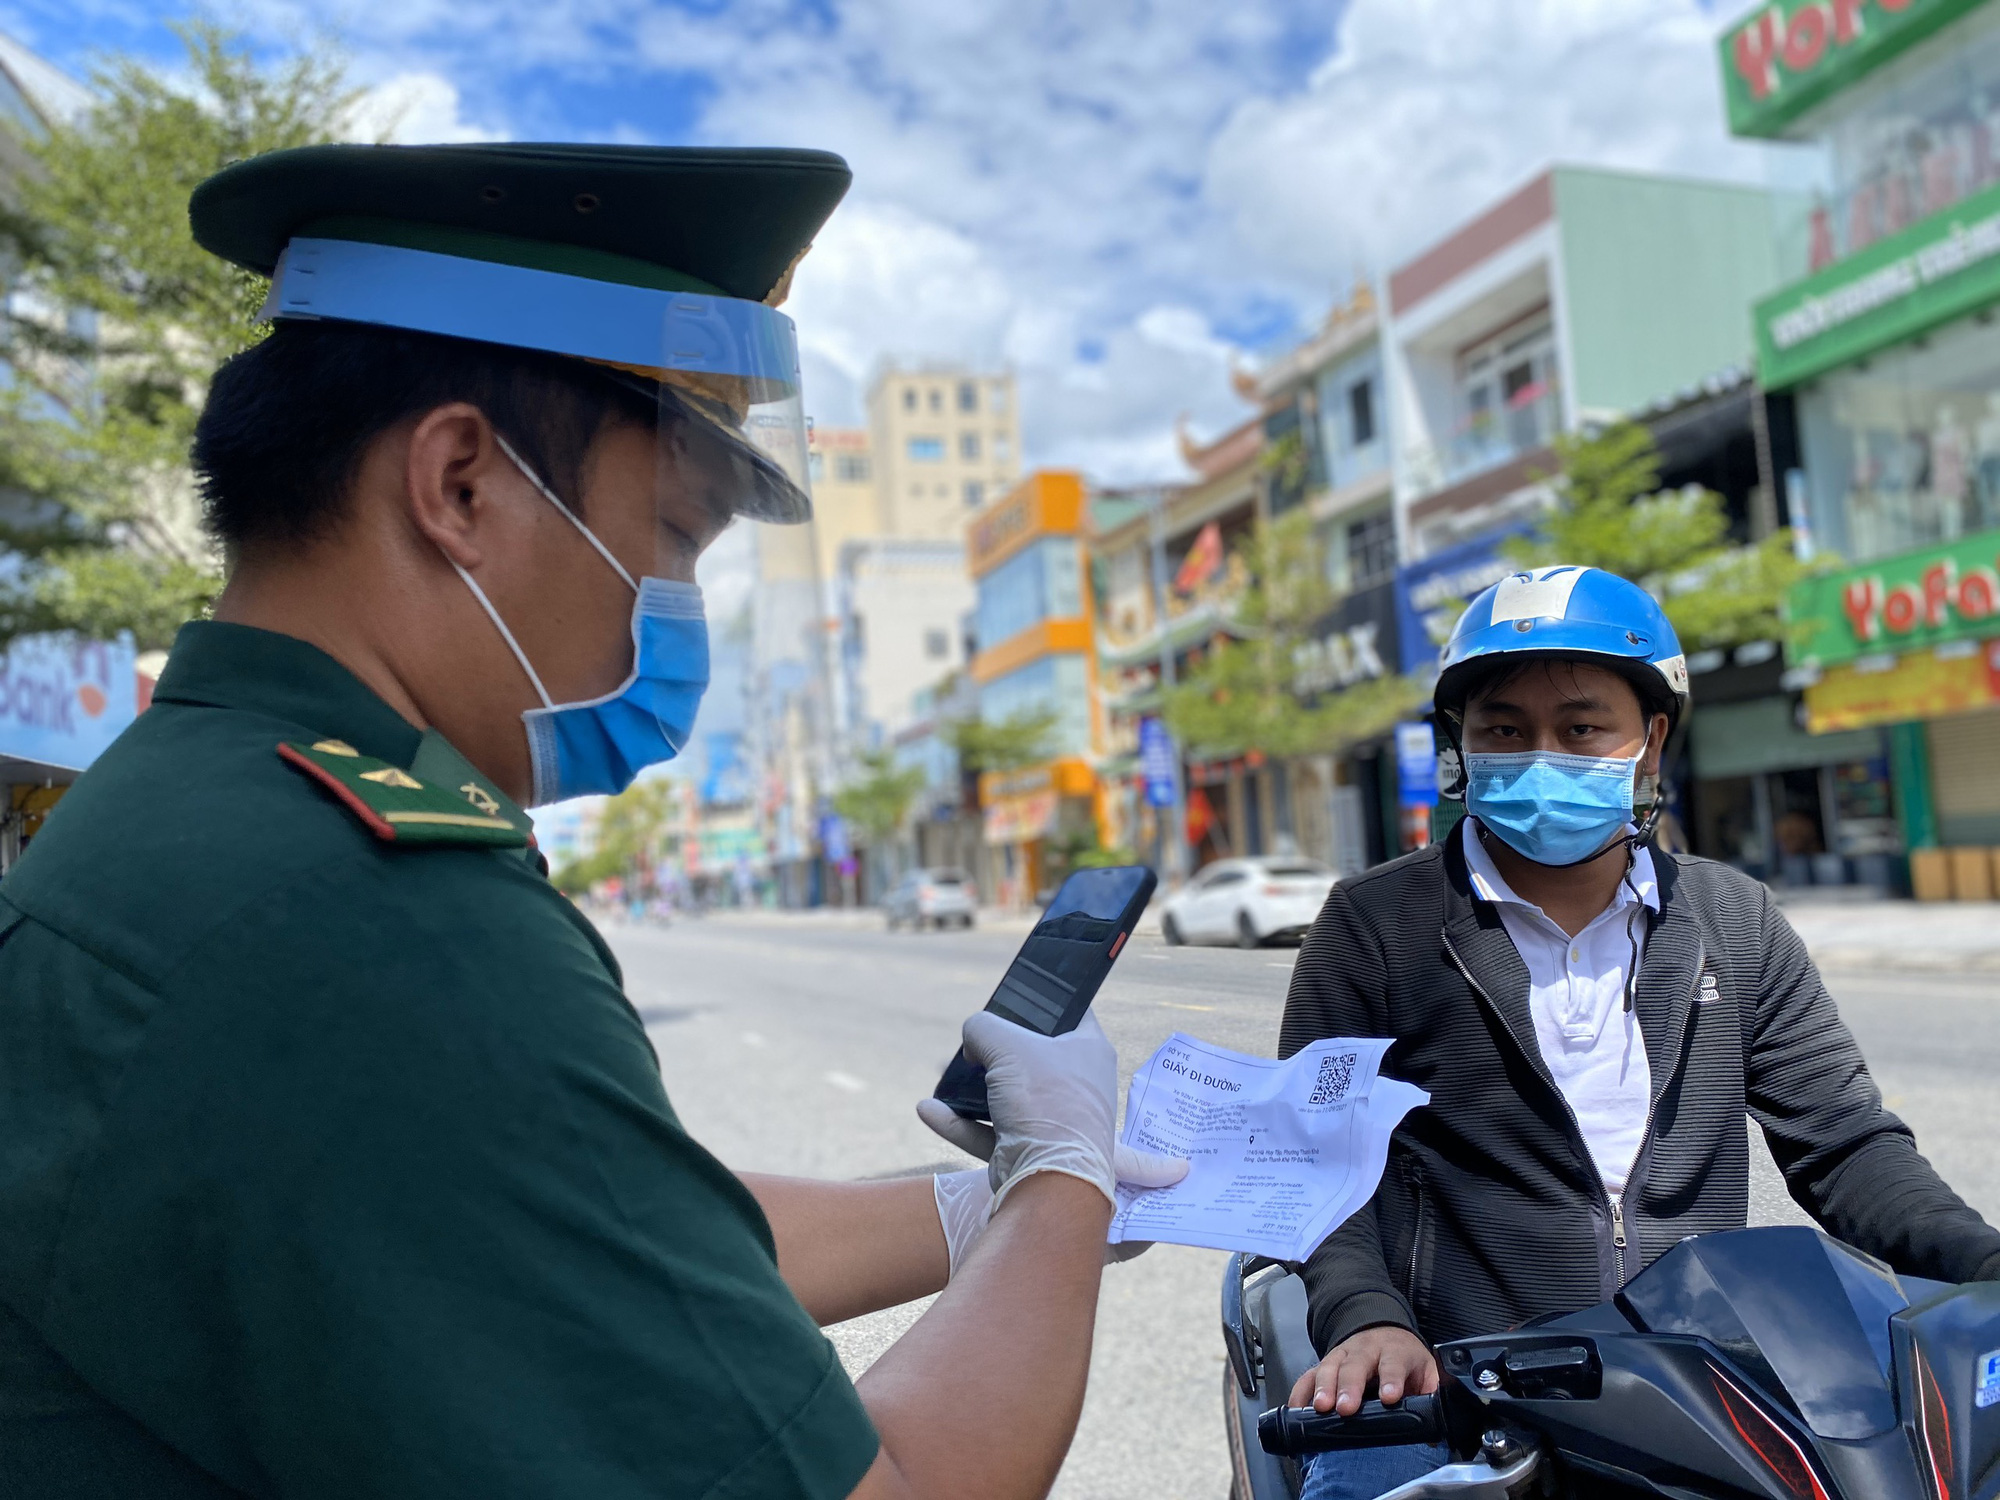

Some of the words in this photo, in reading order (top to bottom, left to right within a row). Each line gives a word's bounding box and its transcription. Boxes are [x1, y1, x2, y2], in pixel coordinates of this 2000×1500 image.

[1162, 1058, 1188, 1077] GIẤY
[1189, 1070, 1202, 1083] ĐI
[1203, 1075, 1242, 1093] ĐƯỜNG
